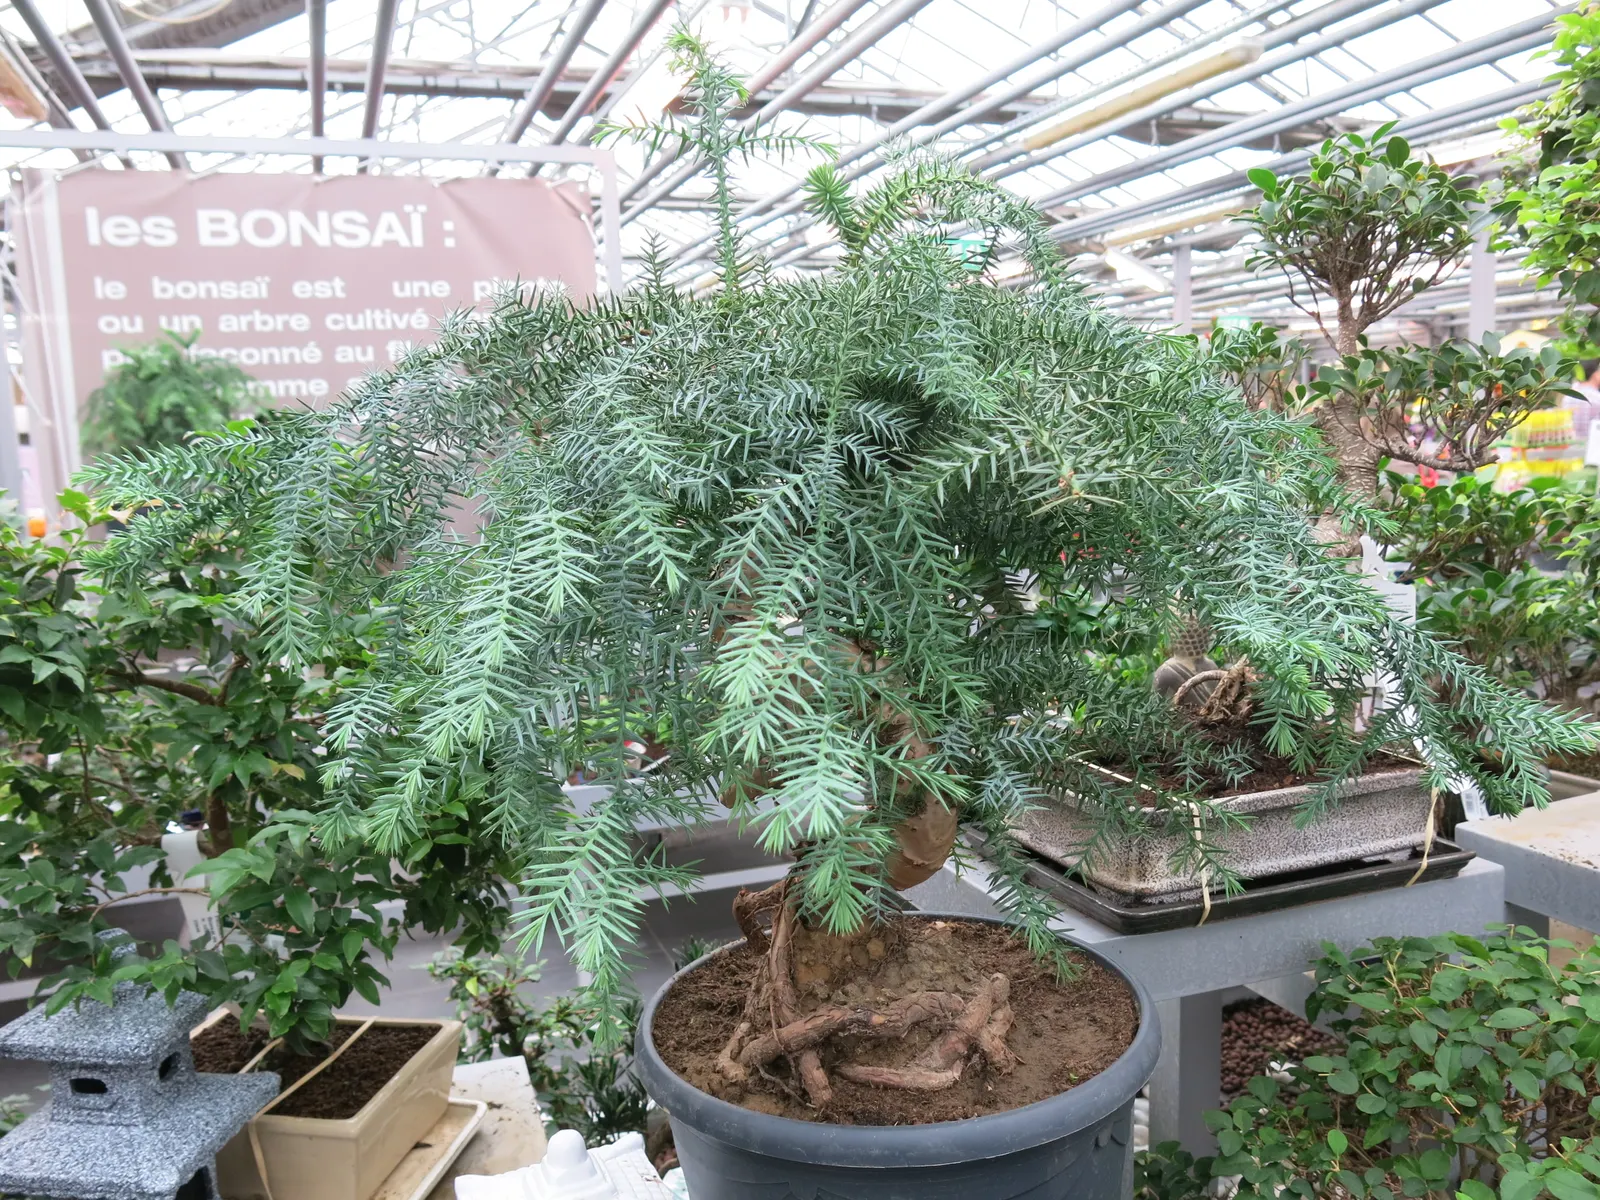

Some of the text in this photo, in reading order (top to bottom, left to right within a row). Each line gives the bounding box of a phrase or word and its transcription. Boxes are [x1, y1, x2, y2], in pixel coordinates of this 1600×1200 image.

[85, 206, 178, 248] les
[196, 203, 428, 248] BONSAÏ
[93, 275, 128, 300] le
[151, 275, 272, 300] bonsaï
[291, 275, 347, 299] est
[391, 279, 452, 299] une
[97, 314, 145, 335] ou
[158, 314, 203, 334] un
[217, 309, 312, 333] arbre
[324, 307, 430, 331] cultivé
[333, 344, 375, 364] au
